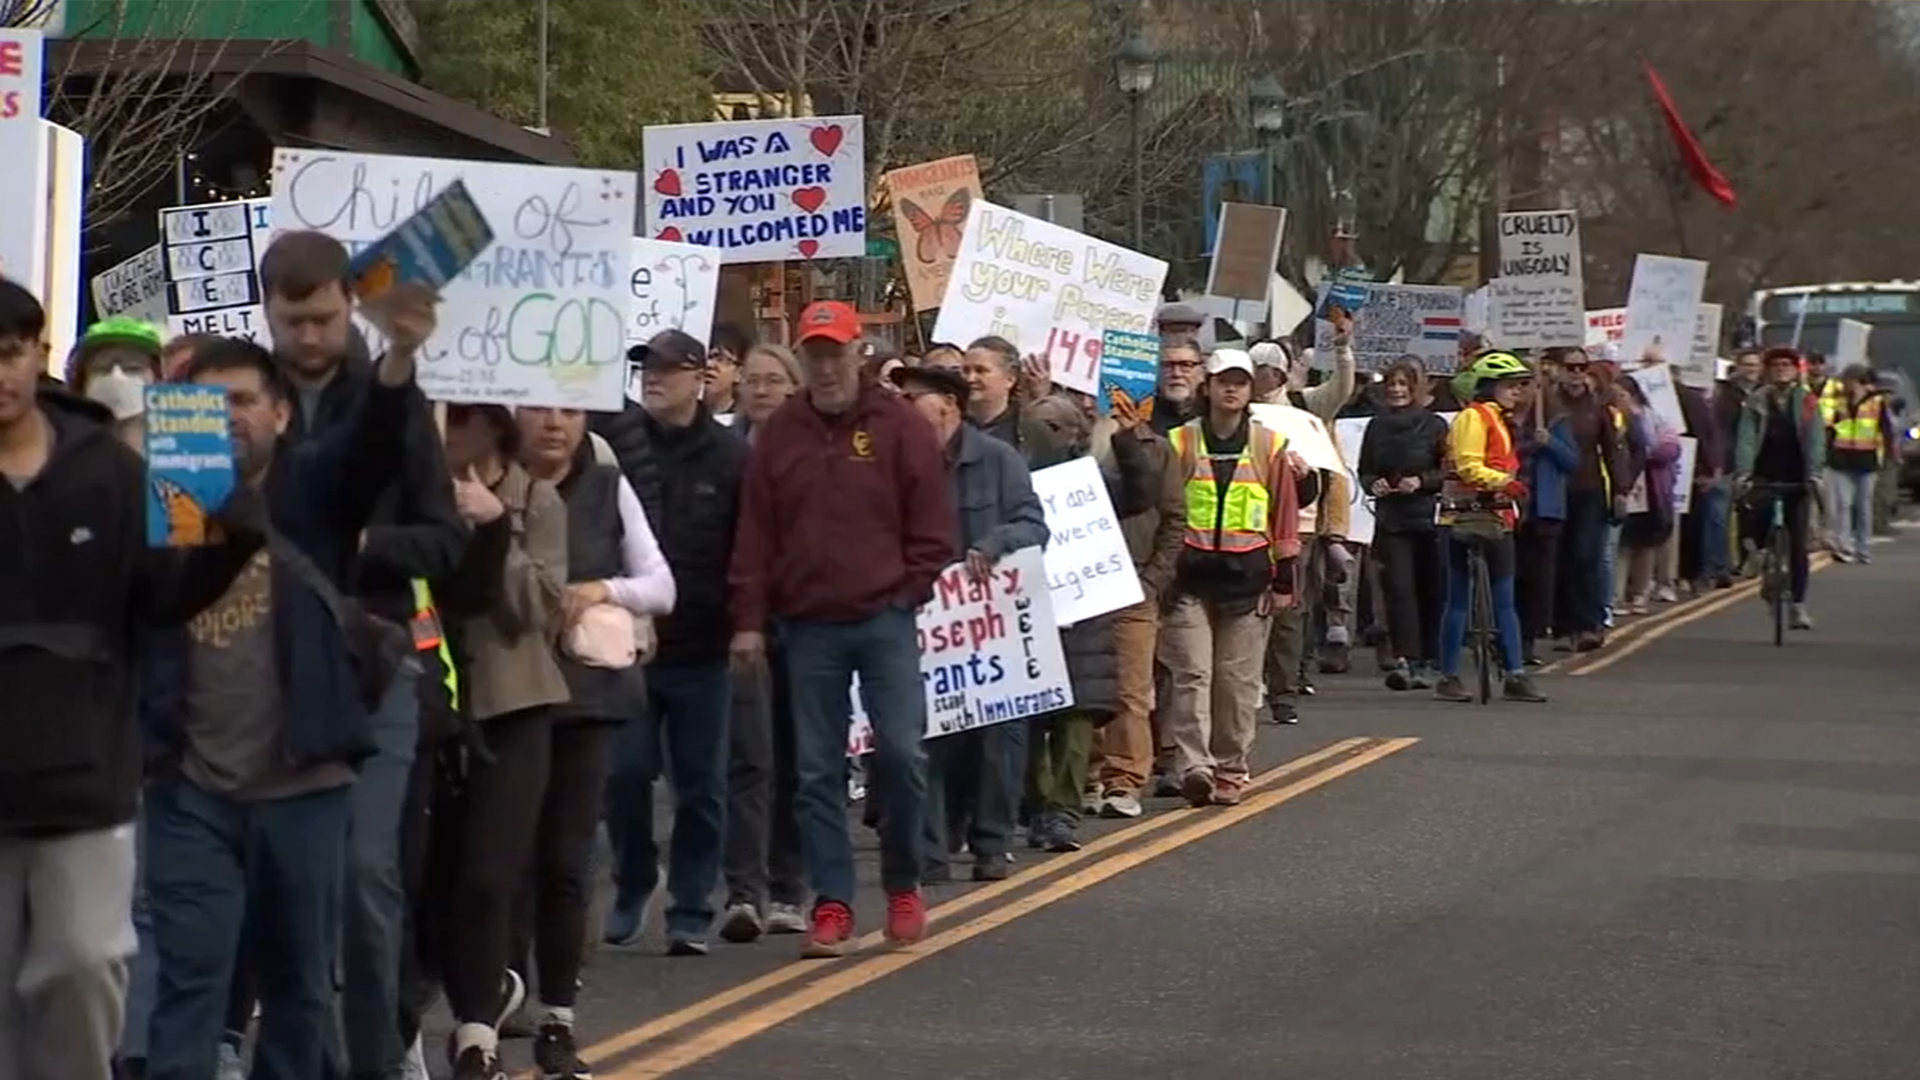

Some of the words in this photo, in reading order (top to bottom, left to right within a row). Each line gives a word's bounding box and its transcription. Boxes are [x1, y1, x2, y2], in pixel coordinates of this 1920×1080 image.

[677, 146, 685, 168] I
[697, 136, 757, 163] WAS
[764, 132, 790, 153] A
[696, 163, 831, 194] STRANGER
[515, 181, 609, 258] of
[660, 196, 716, 219] AND
[723, 193, 775, 215] YOU
[833, 206, 864, 234] ME
[976, 210, 1075, 276] Where
[1083, 246, 1157, 302] Were
[1521, 241, 1543, 255] IS
[463, 244, 619, 290] GRANTS
[1503, 253, 1571, 277] UNGODLY
[631, 267, 652, 299] e
[962, 261, 1049, 304] your
[183, 311, 253, 337] MELT
[637, 299, 660, 327] of
[1589, 314, 1626, 328] WELC
[458, 306, 507, 366] of
[506, 292, 623, 367] GOD
[1104, 333, 1159, 351] Catholics
[1046, 327, 1104, 381] 149
[1104, 346, 1158, 366] Standing
[147, 388, 225, 410] Catholics
[148, 412, 228, 441] Standing
[1043, 494, 1058, 516] Y
[1051, 517, 1113, 546] were
[917, 603, 1005, 656] oseph
[939, 708, 976, 732] with
